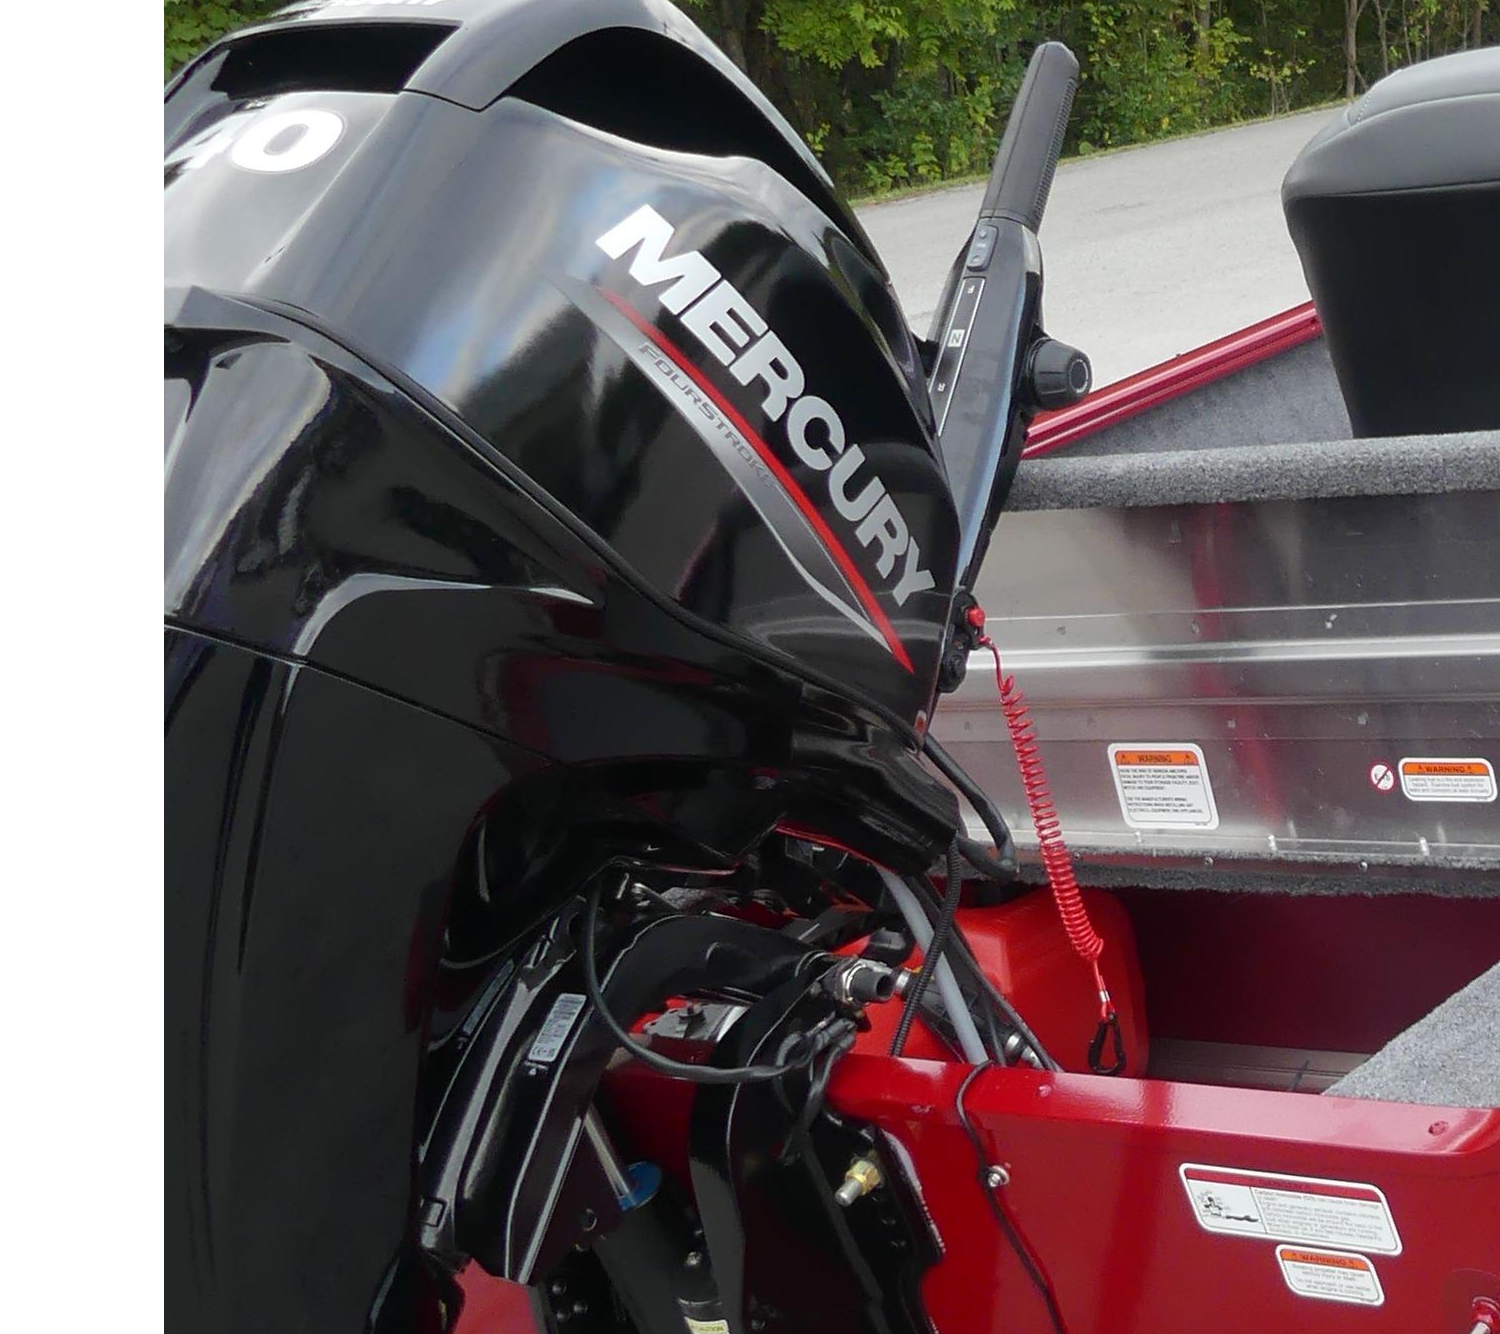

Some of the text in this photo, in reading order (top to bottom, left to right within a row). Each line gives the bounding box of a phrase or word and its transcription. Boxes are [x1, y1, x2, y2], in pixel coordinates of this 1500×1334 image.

[595, 203, 936, 607] MERCURY
[1137, 754, 1173, 763] WARNING
[1425, 765, 1466, 774] WARNING
